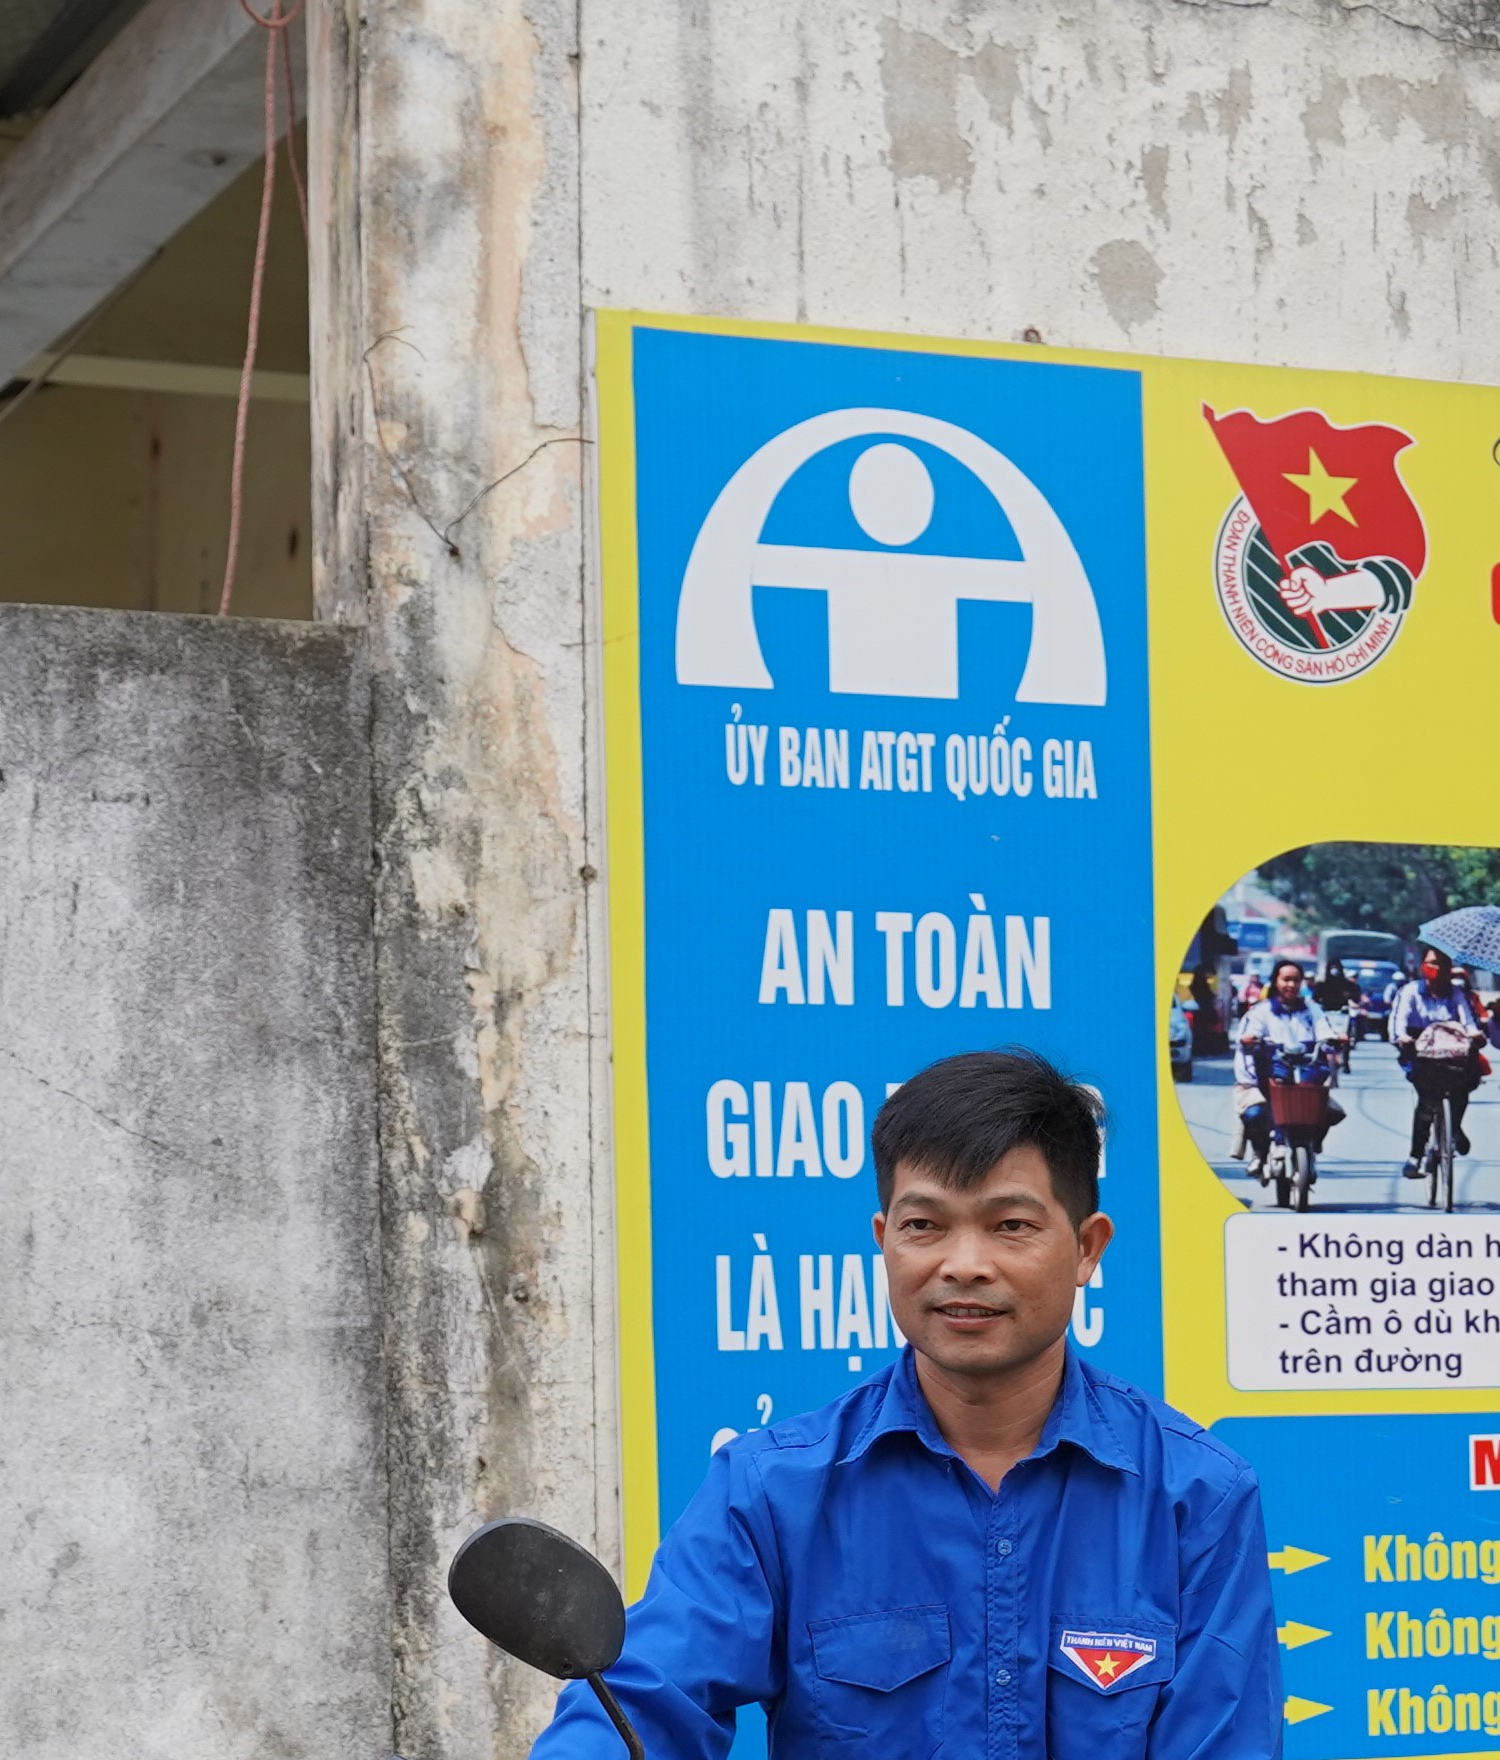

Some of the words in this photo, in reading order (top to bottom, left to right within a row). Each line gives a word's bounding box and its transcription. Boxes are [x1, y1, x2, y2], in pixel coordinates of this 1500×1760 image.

[725, 703, 769, 786] ỦY
[779, 726, 850, 789] BAN
[860, 730, 936, 792] ATGT
[945, 714, 1033, 801] QUỐC
[1043, 738, 1098, 800] GIA
[758, 908, 854, 1006] AN
[875, 893, 1052, 1010] TOÀN
